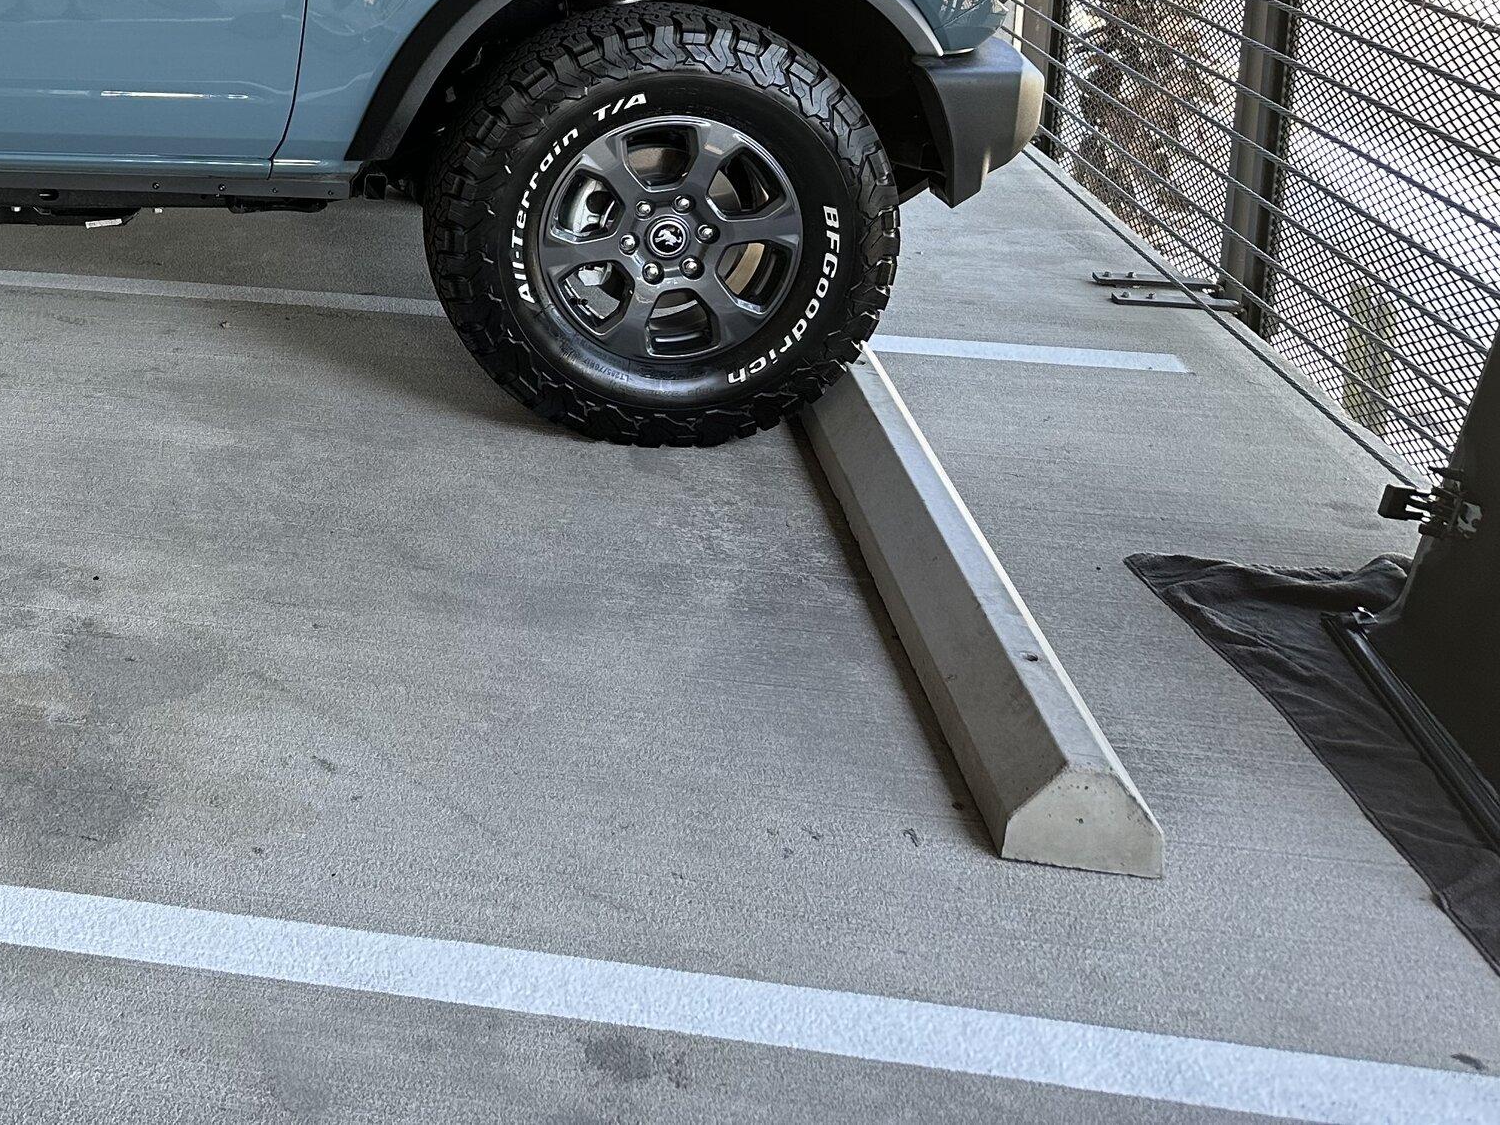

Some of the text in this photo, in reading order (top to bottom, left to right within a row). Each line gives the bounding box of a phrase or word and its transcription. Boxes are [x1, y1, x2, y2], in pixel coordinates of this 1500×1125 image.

[507, 126, 580, 306] All-Terrain
[592, 91, 648, 122] T/A
[727, 204, 842, 387] BFGoodrich
